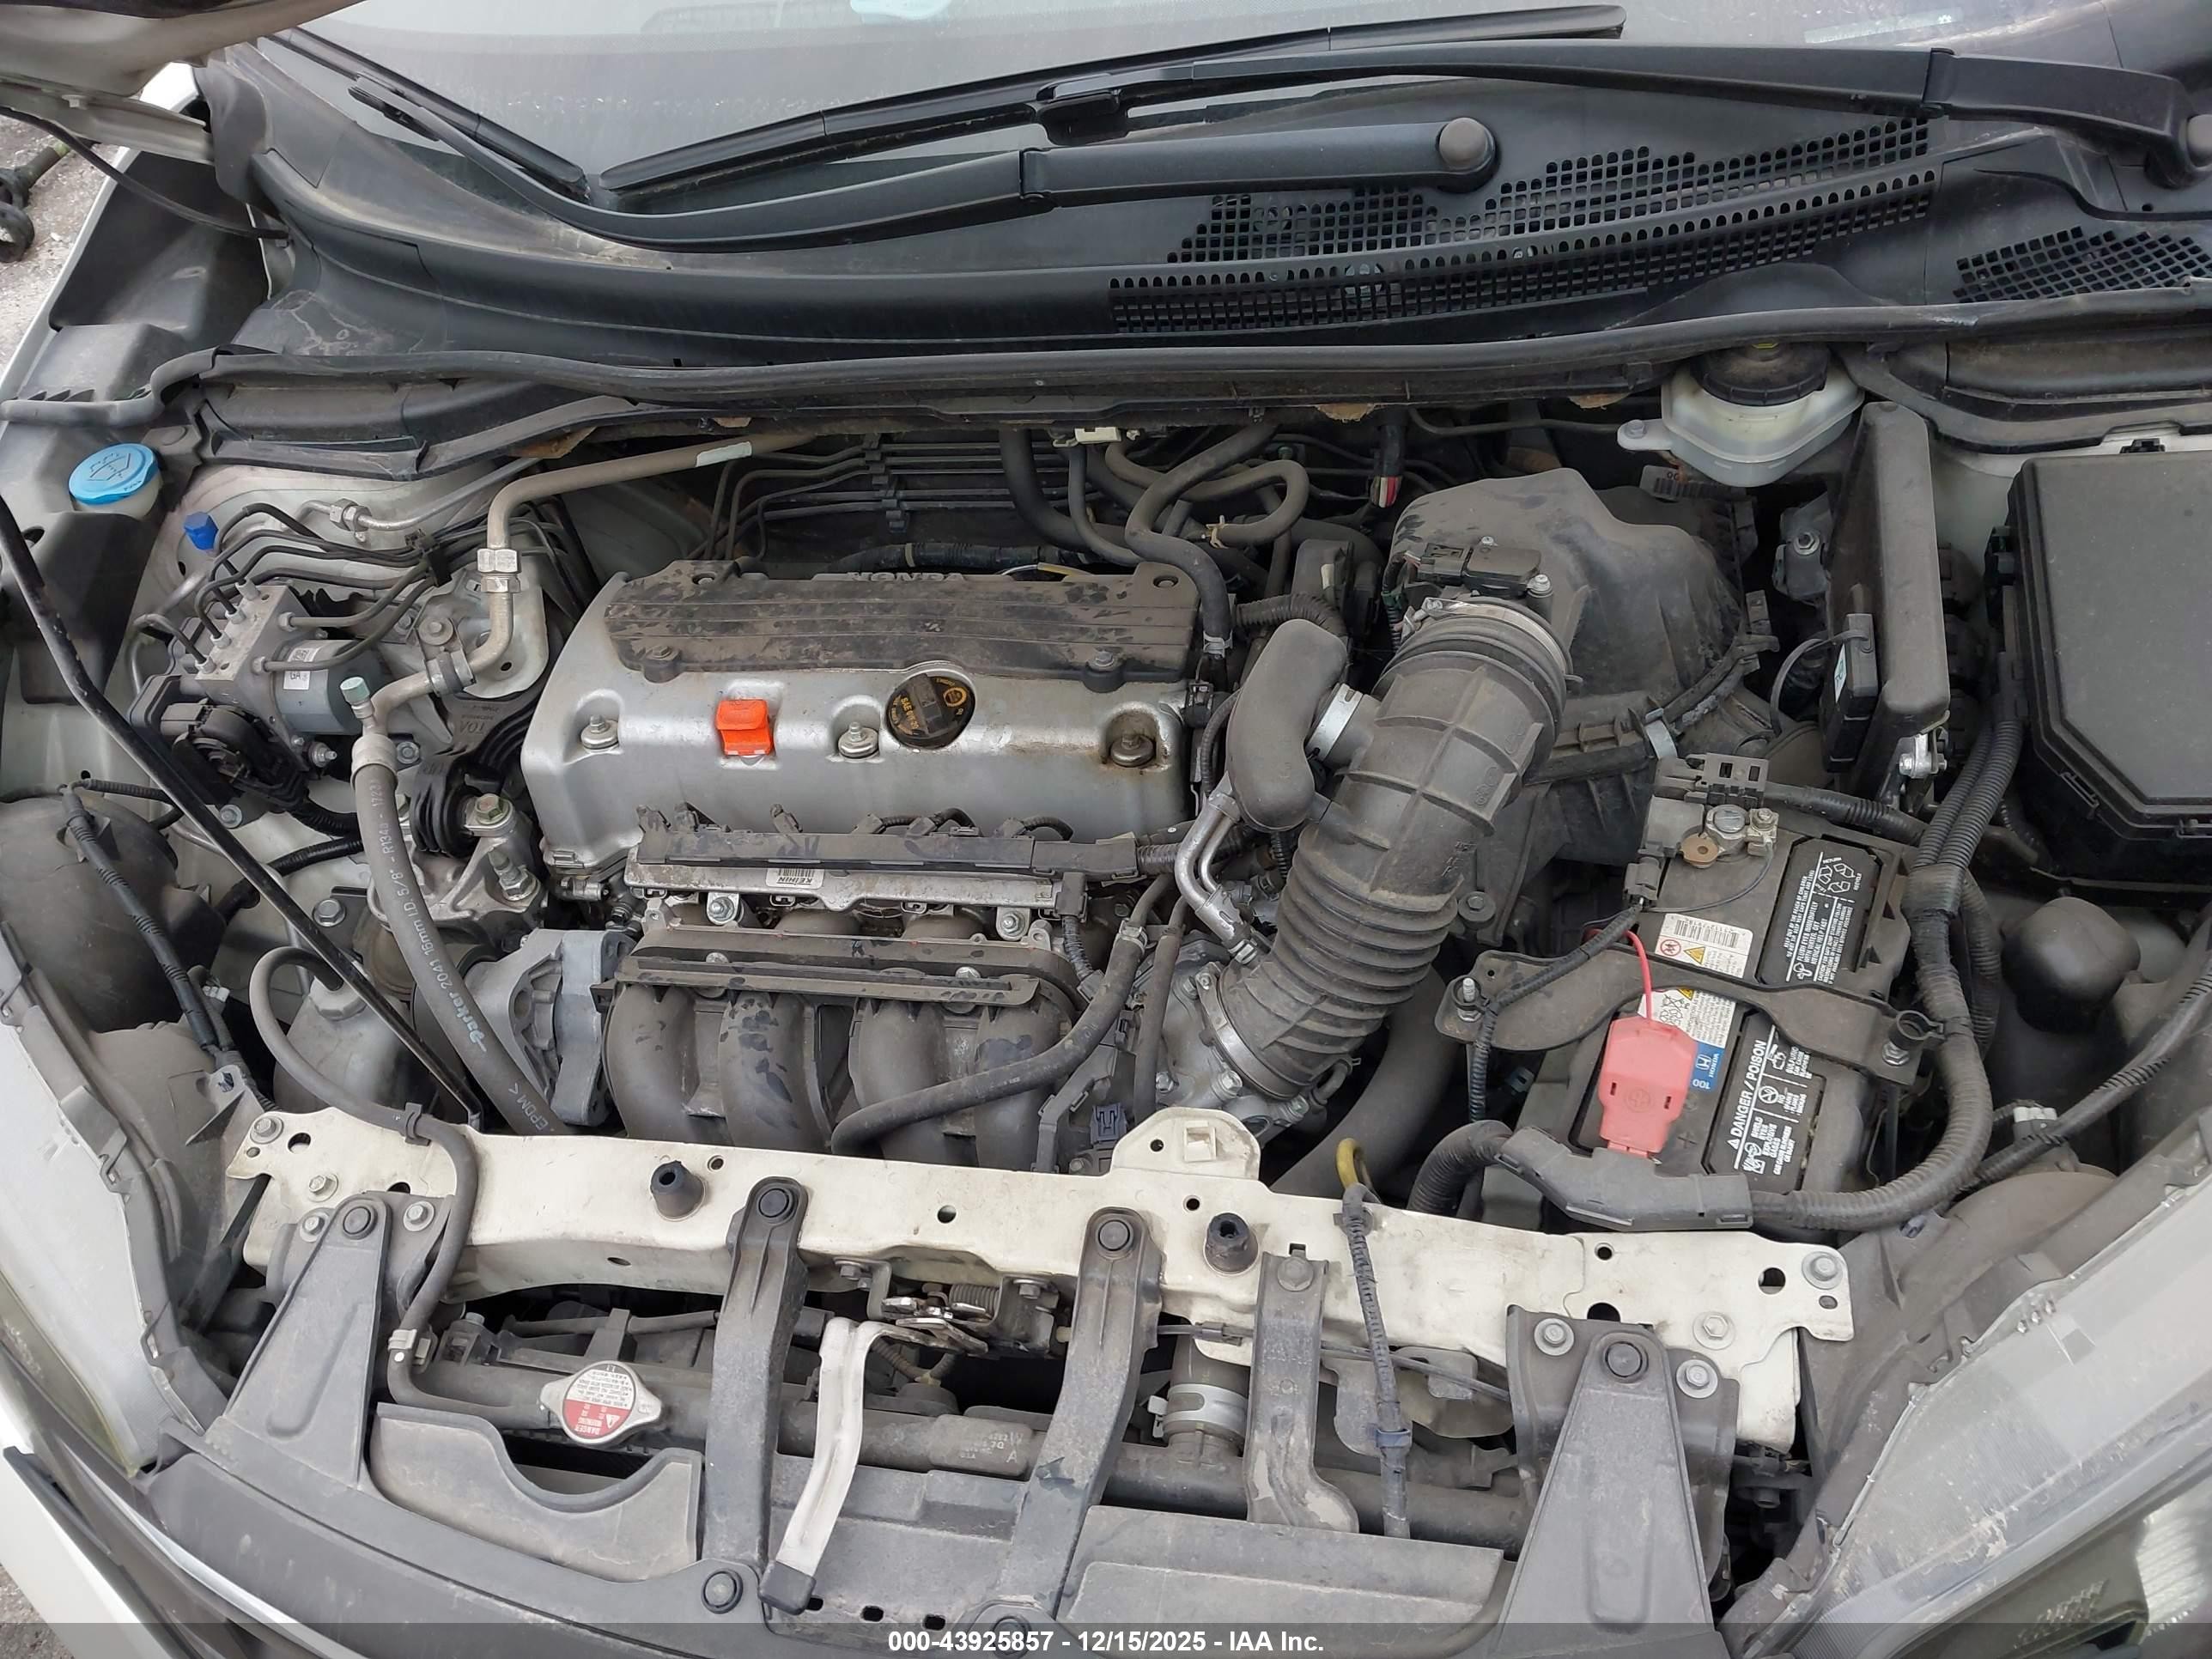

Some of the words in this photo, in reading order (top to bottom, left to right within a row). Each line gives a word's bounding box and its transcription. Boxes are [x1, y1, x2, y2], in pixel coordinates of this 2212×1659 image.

[412, 920, 435, 955] 16mm
[429, 958, 453, 989] 2041
[448, 991, 485, 1048] Parker
[1708, 1052, 1719, 1078] HONDA
